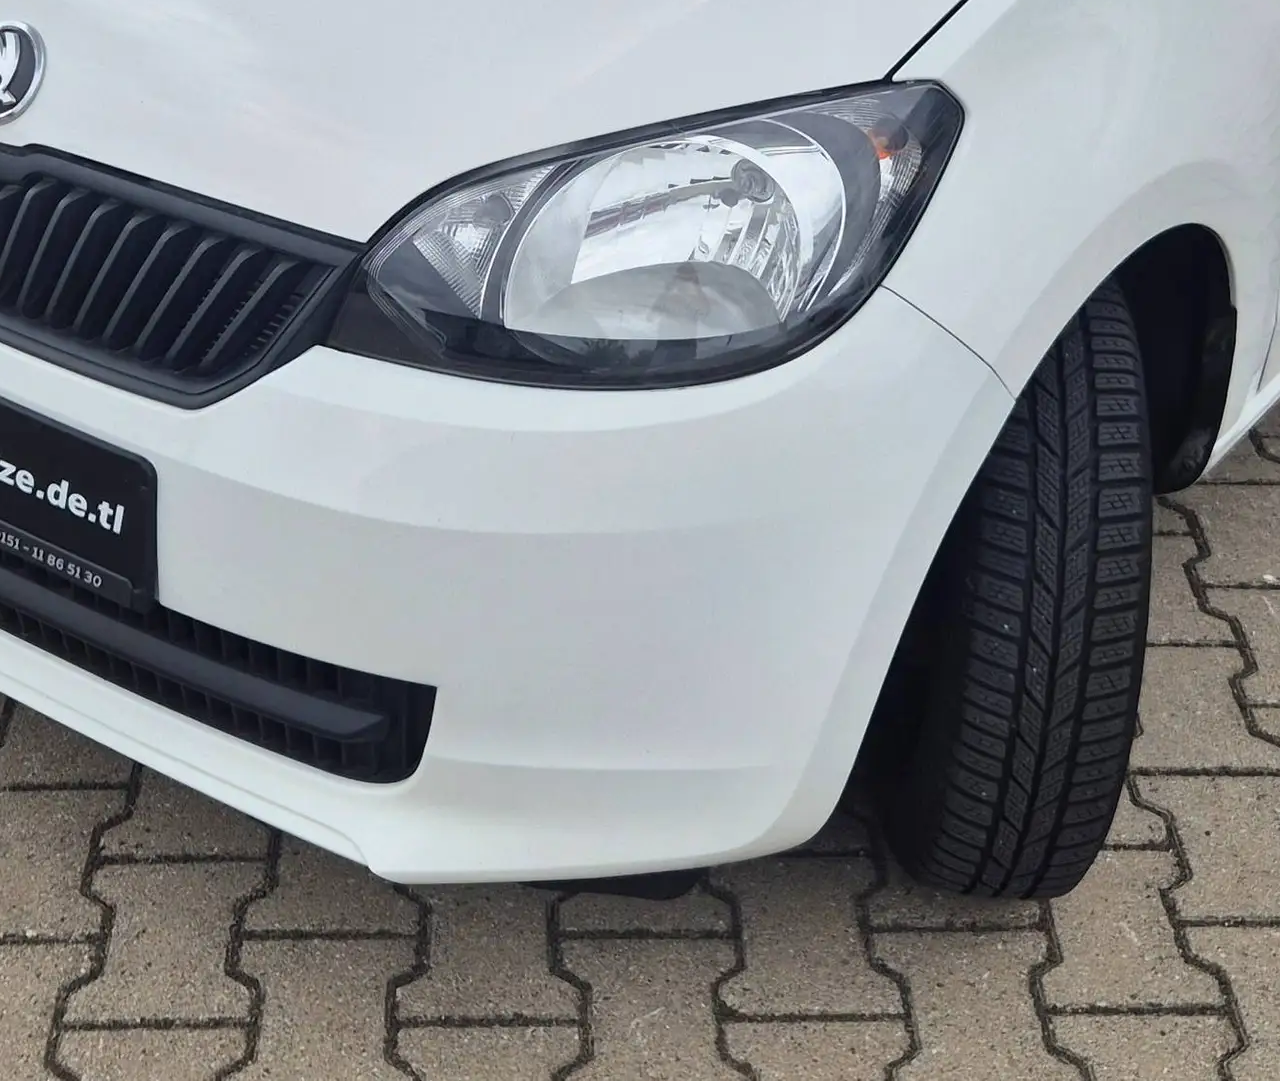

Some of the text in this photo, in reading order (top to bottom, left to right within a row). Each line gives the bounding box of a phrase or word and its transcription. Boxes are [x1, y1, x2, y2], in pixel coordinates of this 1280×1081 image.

[32, 546, 44, 562] 11
[47, 553, 64, 570] 86
[66, 563, 81, 580] 51
[84, 570, 102, 588] 30
